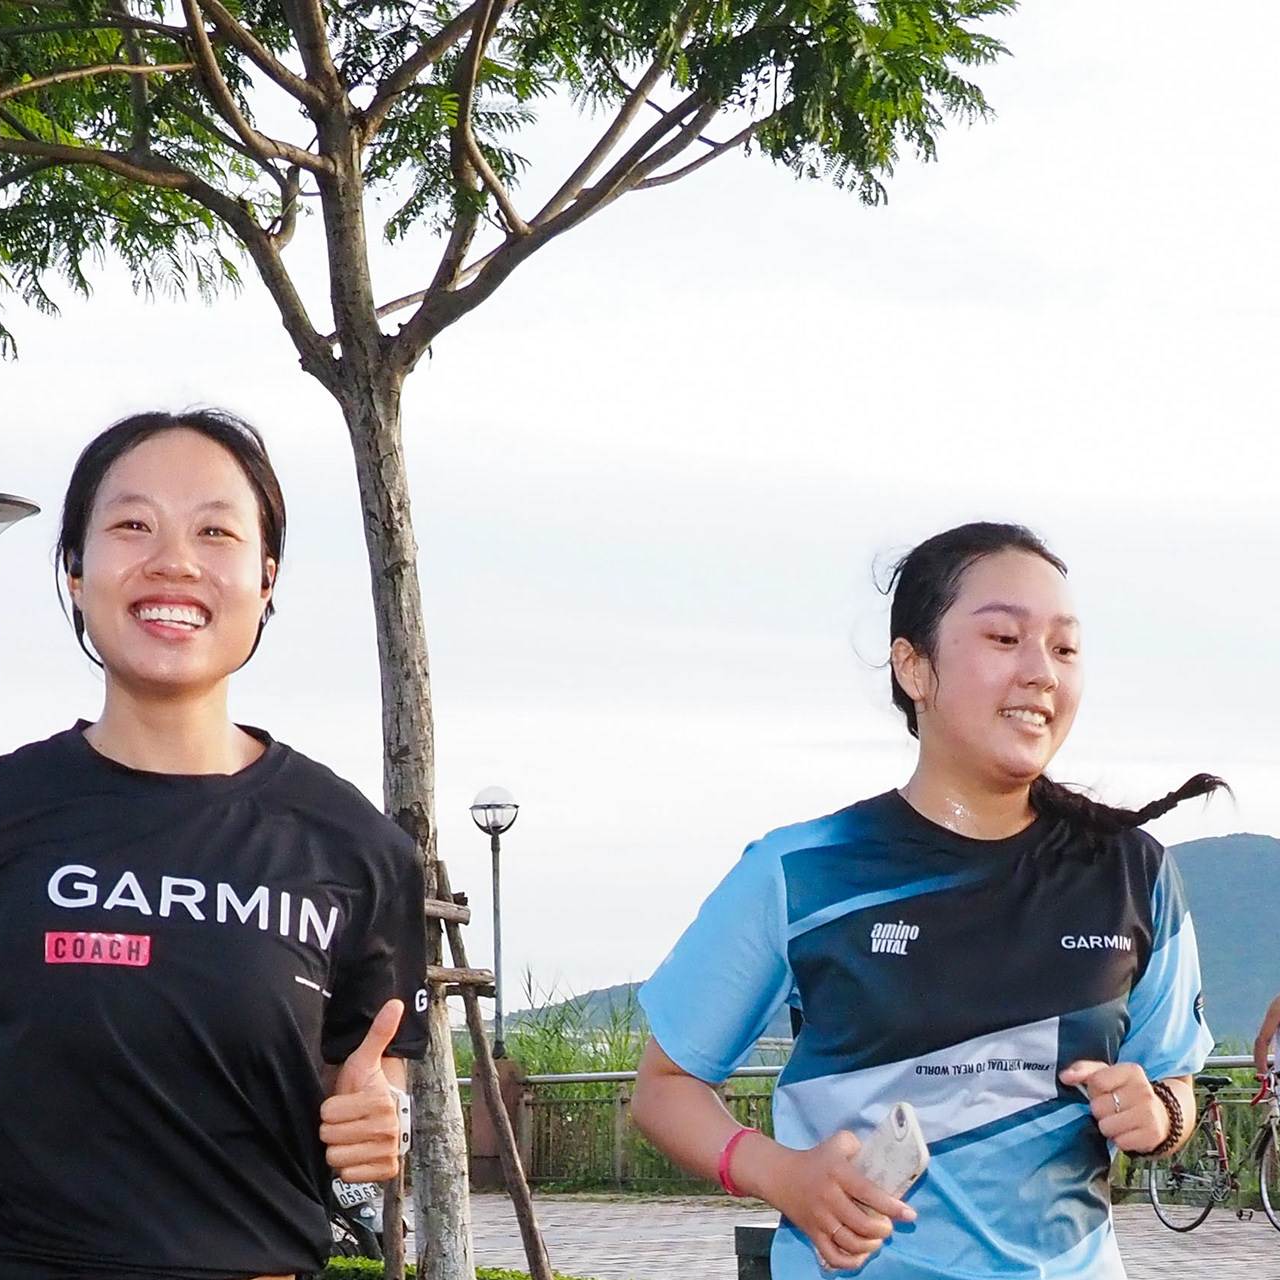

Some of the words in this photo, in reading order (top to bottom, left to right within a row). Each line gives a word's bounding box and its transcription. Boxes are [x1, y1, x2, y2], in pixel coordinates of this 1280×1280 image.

[47, 864, 339, 950] GARMIN
[870, 920, 920, 940] amino
[54, 937, 141, 961] COACH
[871, 938, 908, 955] VITAL
[1061, 935, 1132, 951] GARMIN
[915, 1065, 950, 1076] WORLD
[953, 1063, 974, 1075] REAL
[976, 1062, 986, 1074] TO
[1023, 1062, 1050, 1071] FROM
[340, 1185, 379, 1206] 059.63
